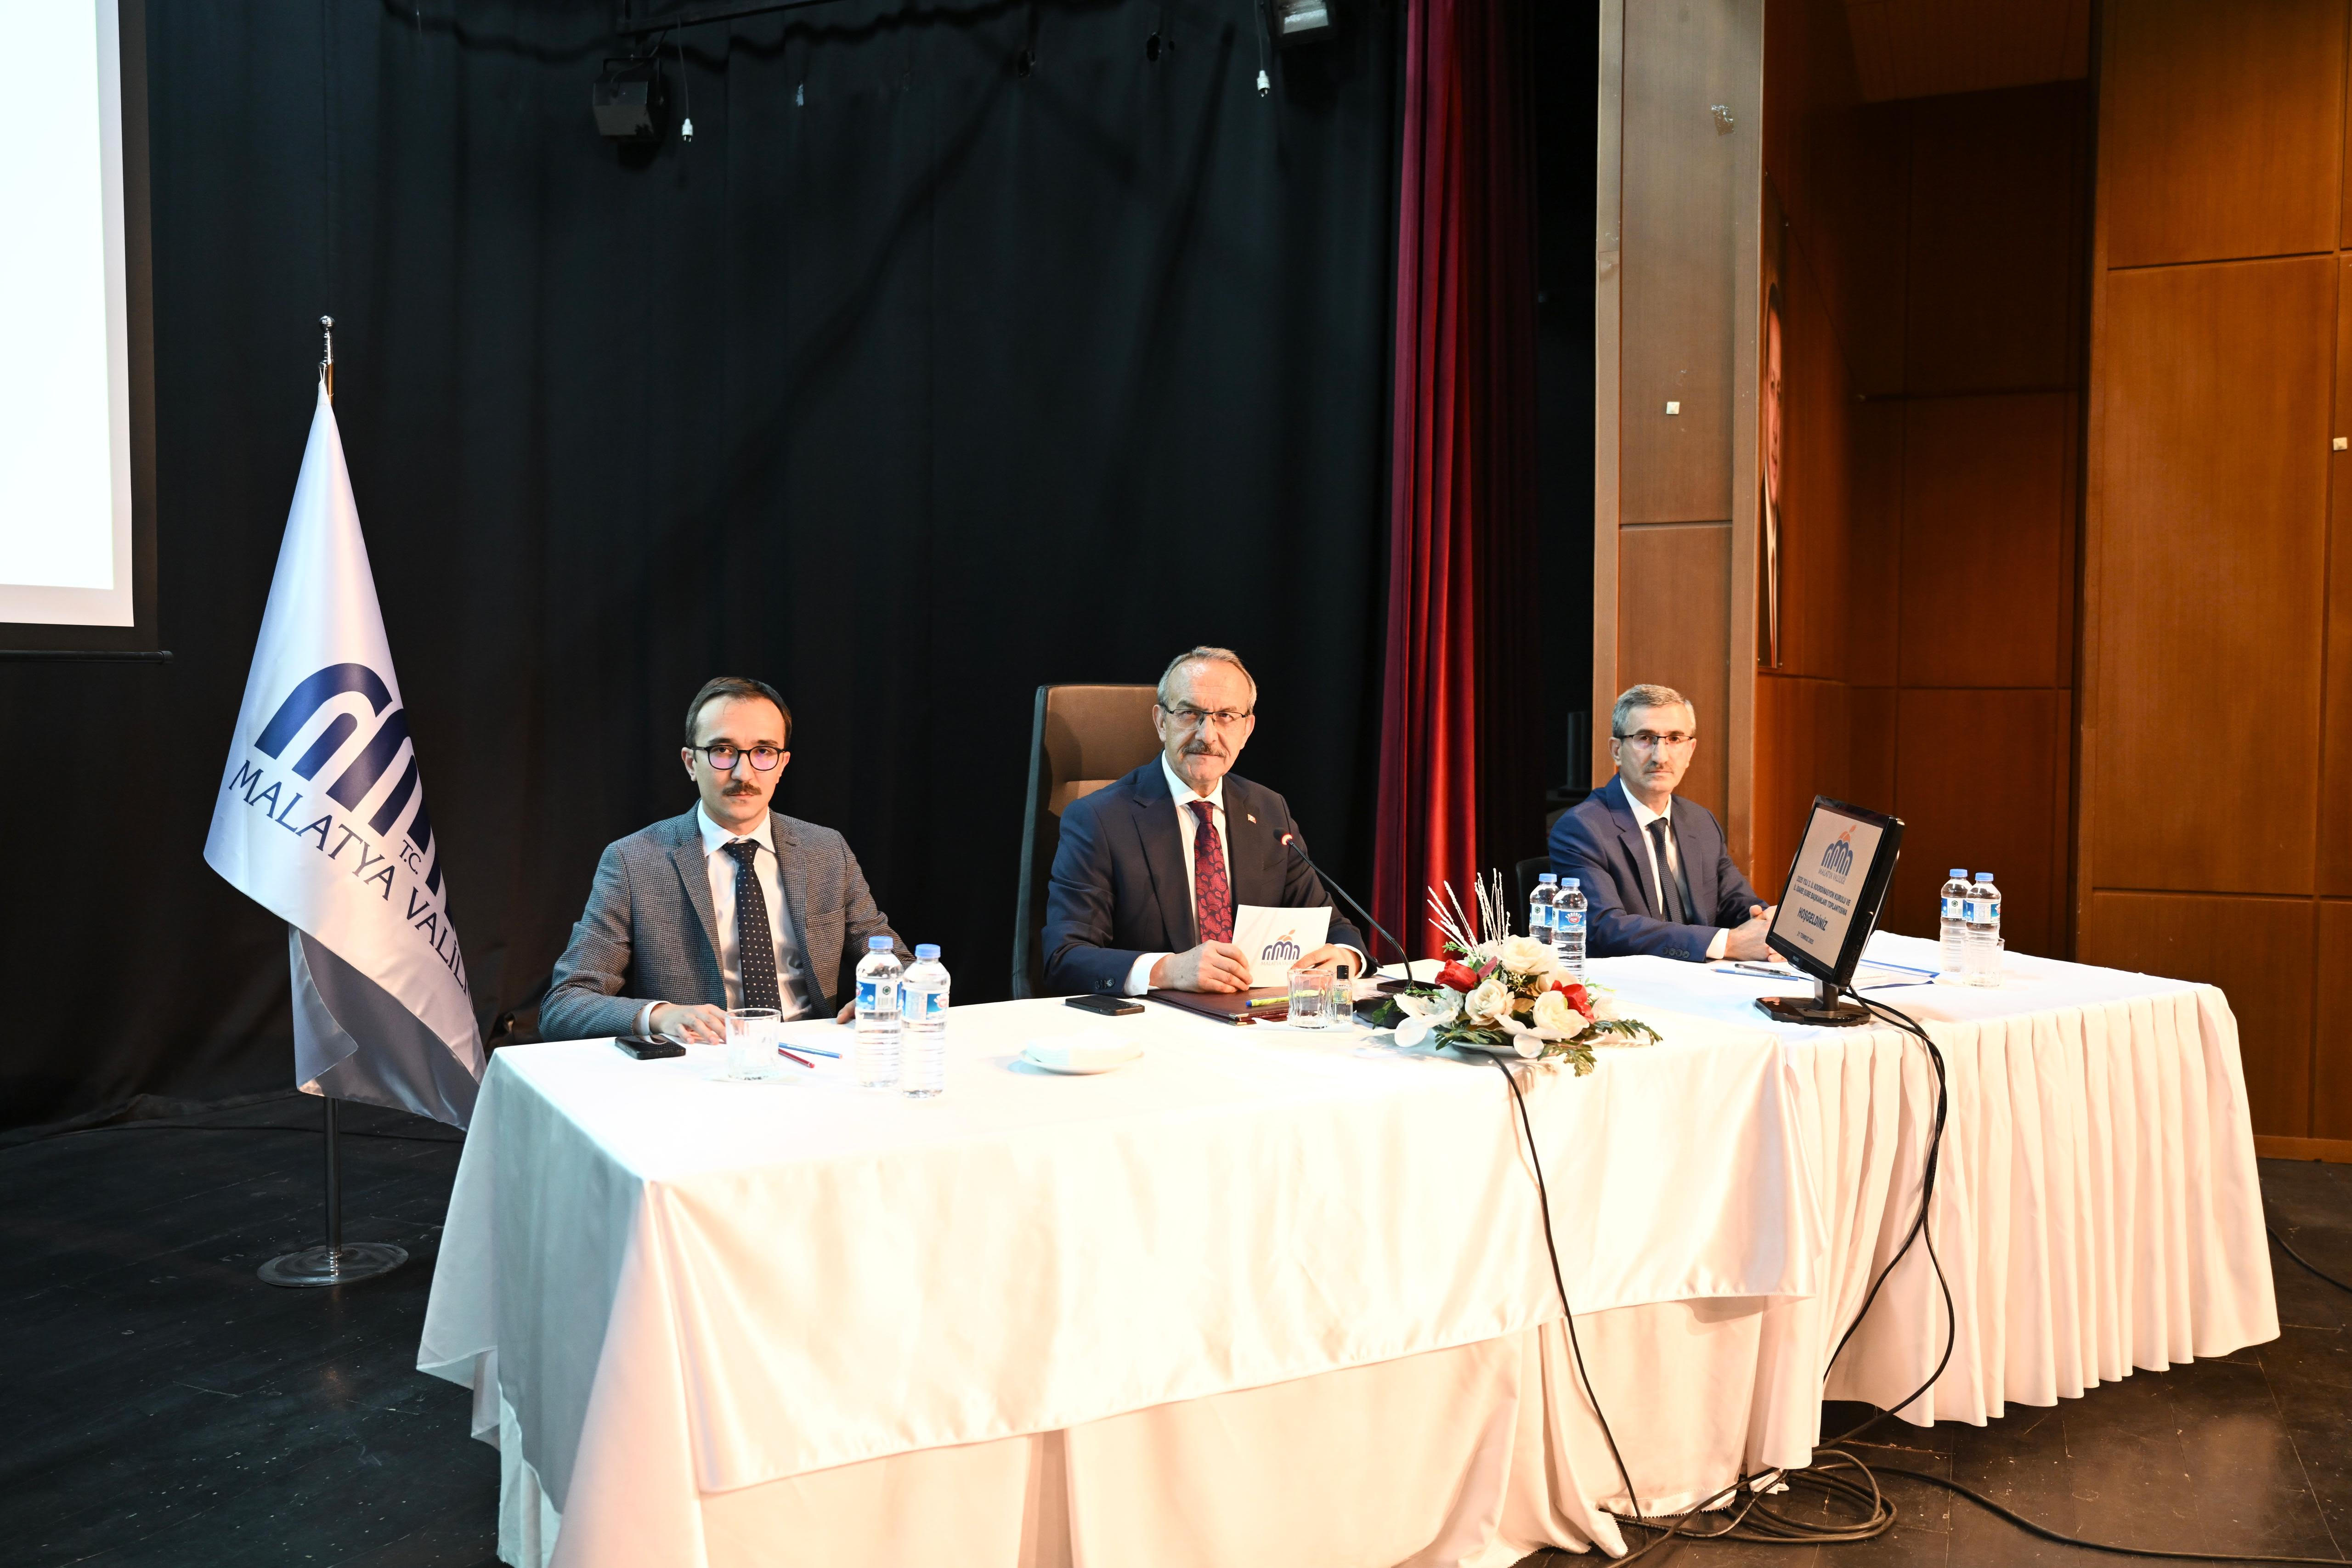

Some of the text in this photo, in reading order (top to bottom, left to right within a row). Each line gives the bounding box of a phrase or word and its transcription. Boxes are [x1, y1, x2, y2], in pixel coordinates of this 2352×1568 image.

[229, 759, 395, 900] MALATYA
[399, 839, 421, 875] T.C.
[1818, 867, 1832, 879] MALATYA
[1810, 892, 1828, 907] BAŞKANLARI
[1827, 900, 1848, 916] TOPLANTISINA
[1813, 883, 1836, 899] KOORDİNASYON
[1834, 892, 1847, 904] KURULU
[1797, 907, 1828, 931] HOŞGELDİNİZ
